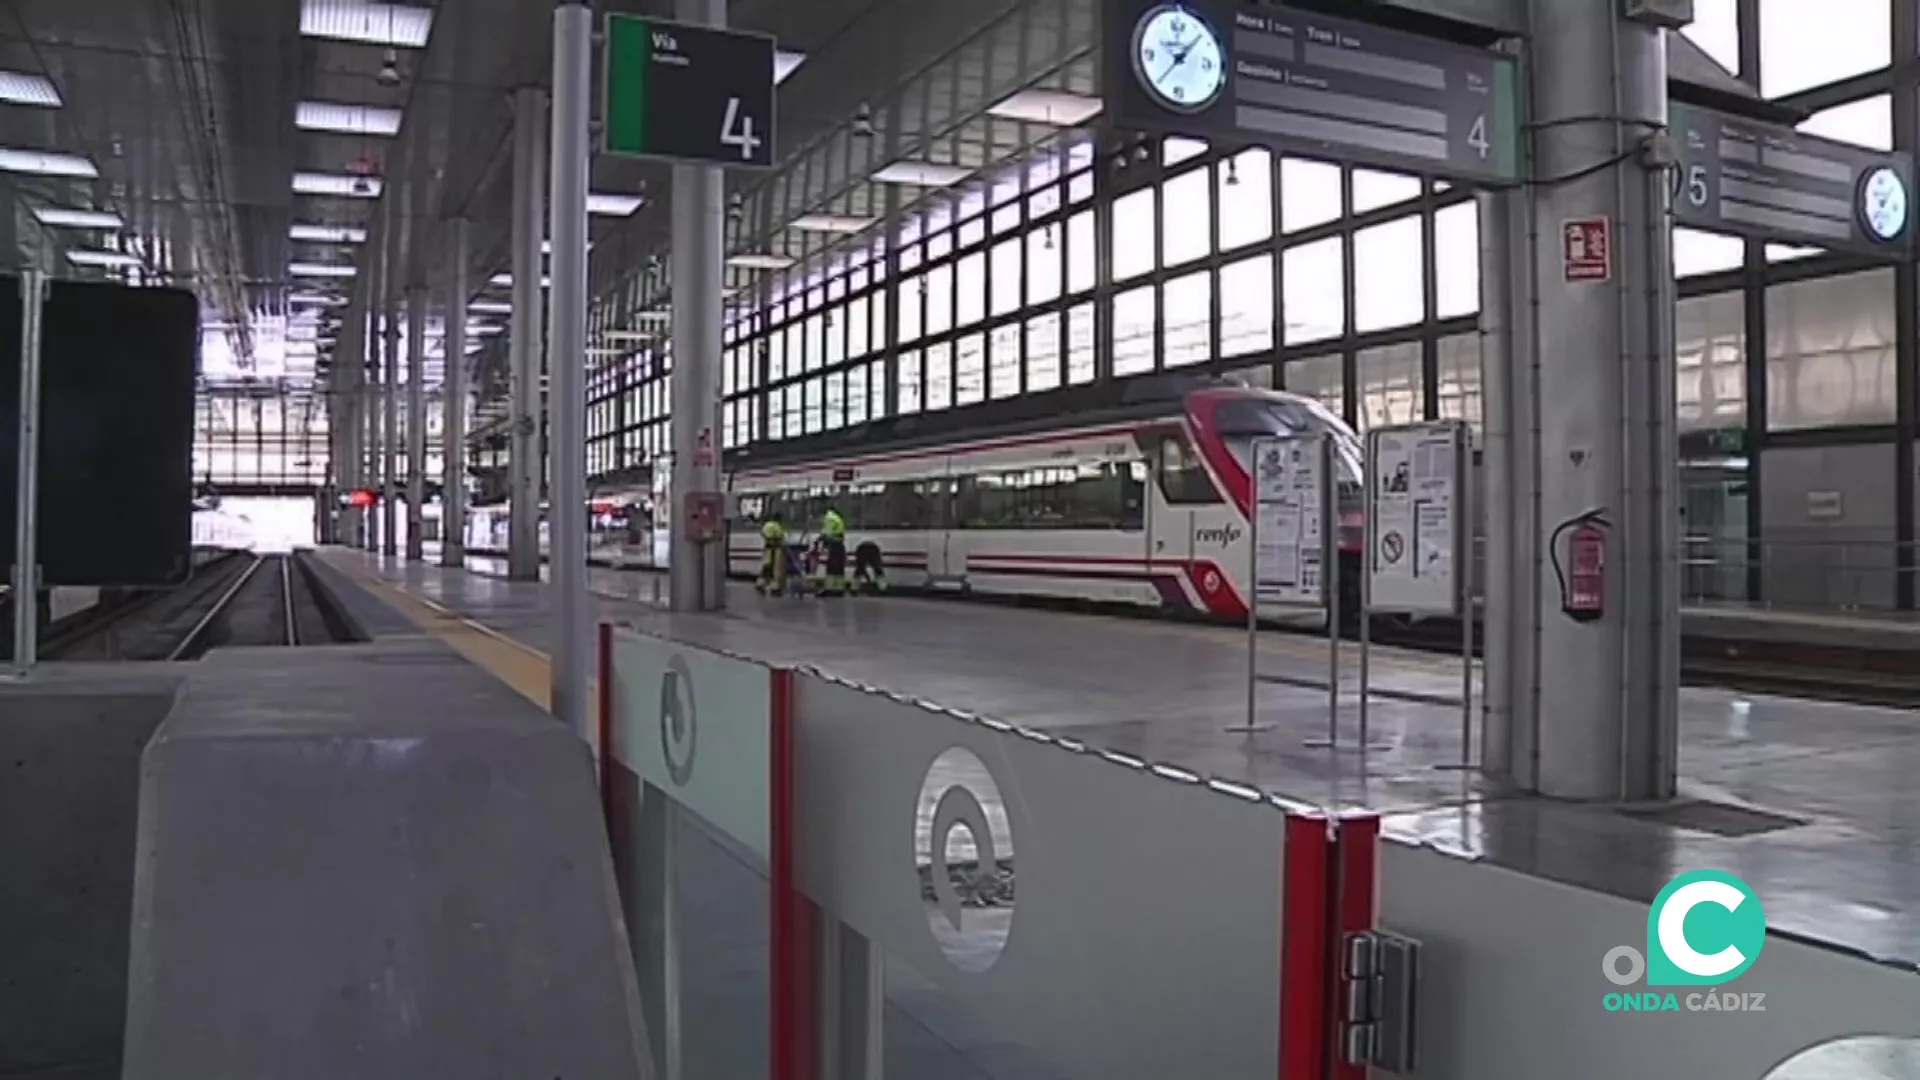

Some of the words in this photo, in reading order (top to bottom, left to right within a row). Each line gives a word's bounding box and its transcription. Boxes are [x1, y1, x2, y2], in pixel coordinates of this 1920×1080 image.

[720, 97, 761, 159] 4
[1467, 115, 1490, 158] 4
[1689, 165, 1707, 206] 5
[1196, 521, 1241, 550] renfe
